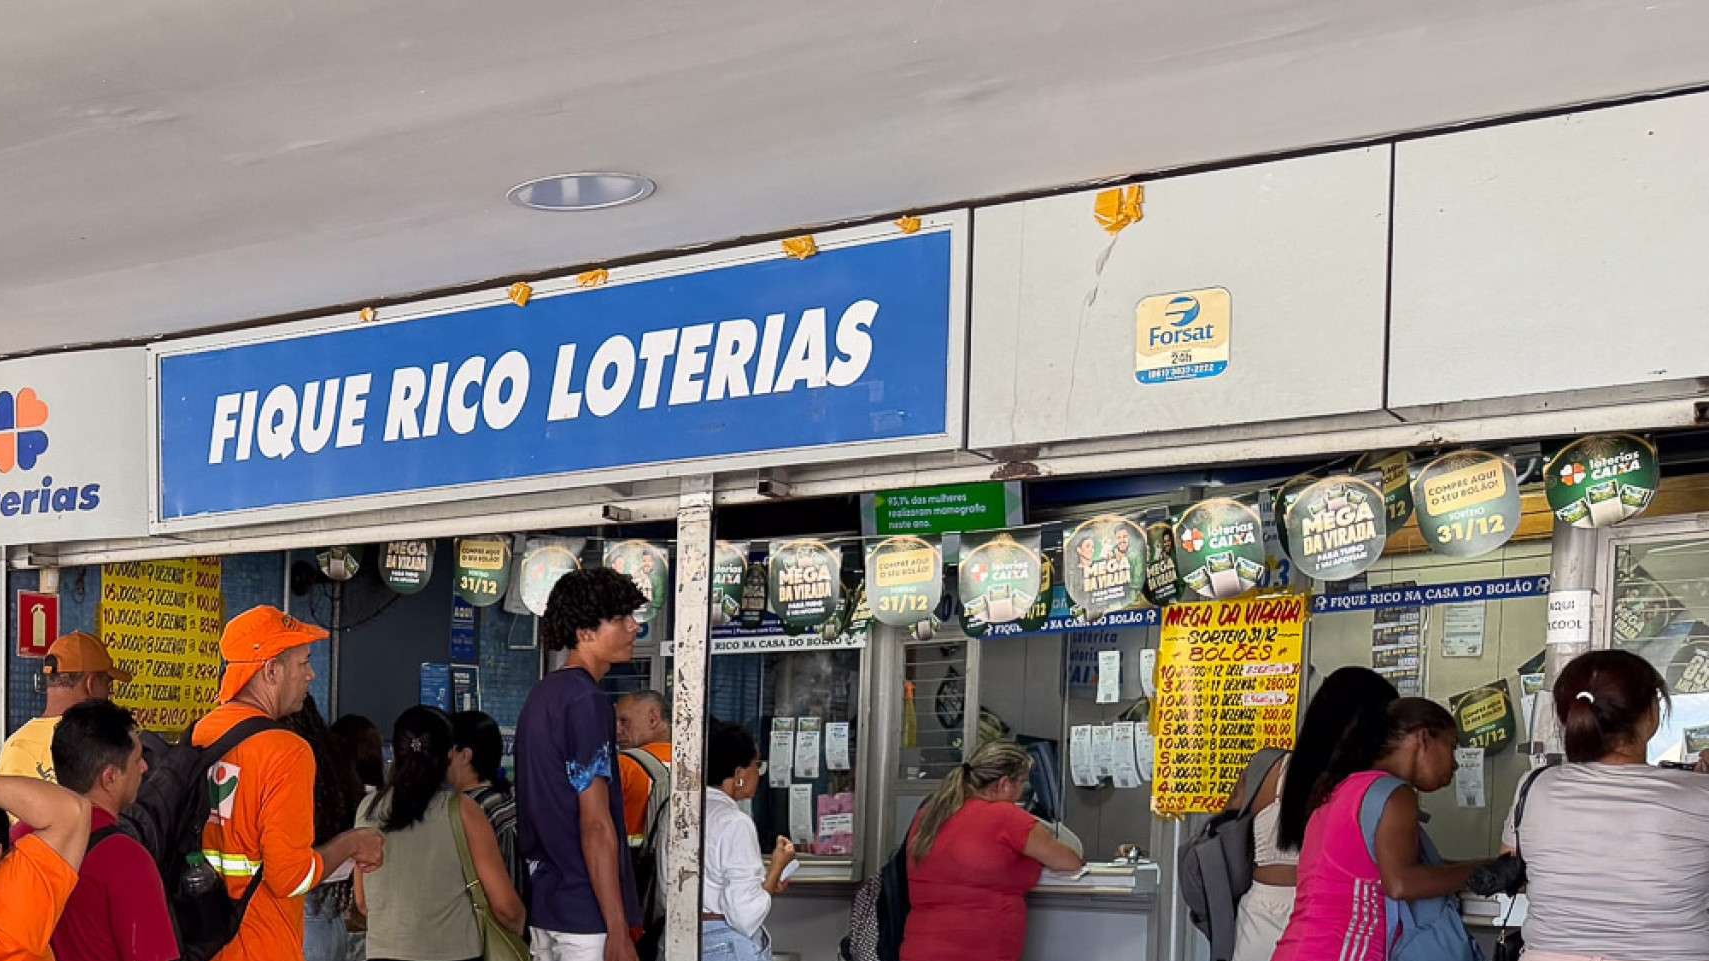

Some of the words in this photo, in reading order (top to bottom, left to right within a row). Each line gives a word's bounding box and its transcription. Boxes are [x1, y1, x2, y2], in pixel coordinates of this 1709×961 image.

[1150, 323, 1214, 346] Forsat
[208, 373, 372, 464] FIQUE
[384, 350, 530, 441] RICO
[546, 299, 880, 421] LOTERIAS
[1588, 450, 1641, 469] loterias
[1592, 460, 1642, 480] CAIXA
[1428, 478, 1469, 496] COMPRE
[1470, 470, 1497, 485] AQUI
[1441, 490, 1459, 504] SEU
[1302, 502, 1375, 536] MEGA
[1323, 520, 1377, 550] VIRADA
[1437, 515, 1505, 544] 31/12
[388, 541, 428, 556] MEGA
[1209, 532, 1255, 548] CAIXA
[779, 566, 832, 585] MEGA
[1084, 559, 1131, 578] MEGA
[460, 575, 497, 594] 31/12
[879, 594, 928, 614] 31/12
[1330, 594, 1367, 609] FIQUE
[1370, 592, 1401, 604] RICO
[1404, 590, 1422, 601] NA
[1425, 588, 1459, 600] CASA
[1463, 586, 1483, 597] DO
[1486, 581, 1532, 595] BOLÃO
[1109, 611, 1143, 625] BOLÃO
[1165, 603, 1212, 627] MEGA
[1218, 602, 1241, 625] DA
[1246, 600, 1301, 624] VIRADA
[715, 641, 740, 650] RICO
[758, 638, 786, 648] CASA
[789, 638, 804, 647] DO
[1188, 629, 1246, 645] SORTEIO
[1248, 627, 1278, 646] 31/12
[1189, 643, 1272, 662] BOLÕES
[1160, 752, 1170, 764] 5
[1157, 766, 1171, 780] 10
[1209, 767, 1216, 779] 7
[1158, 781, 1169, 794] 4
[1209, 781, 1216, 794] 7
